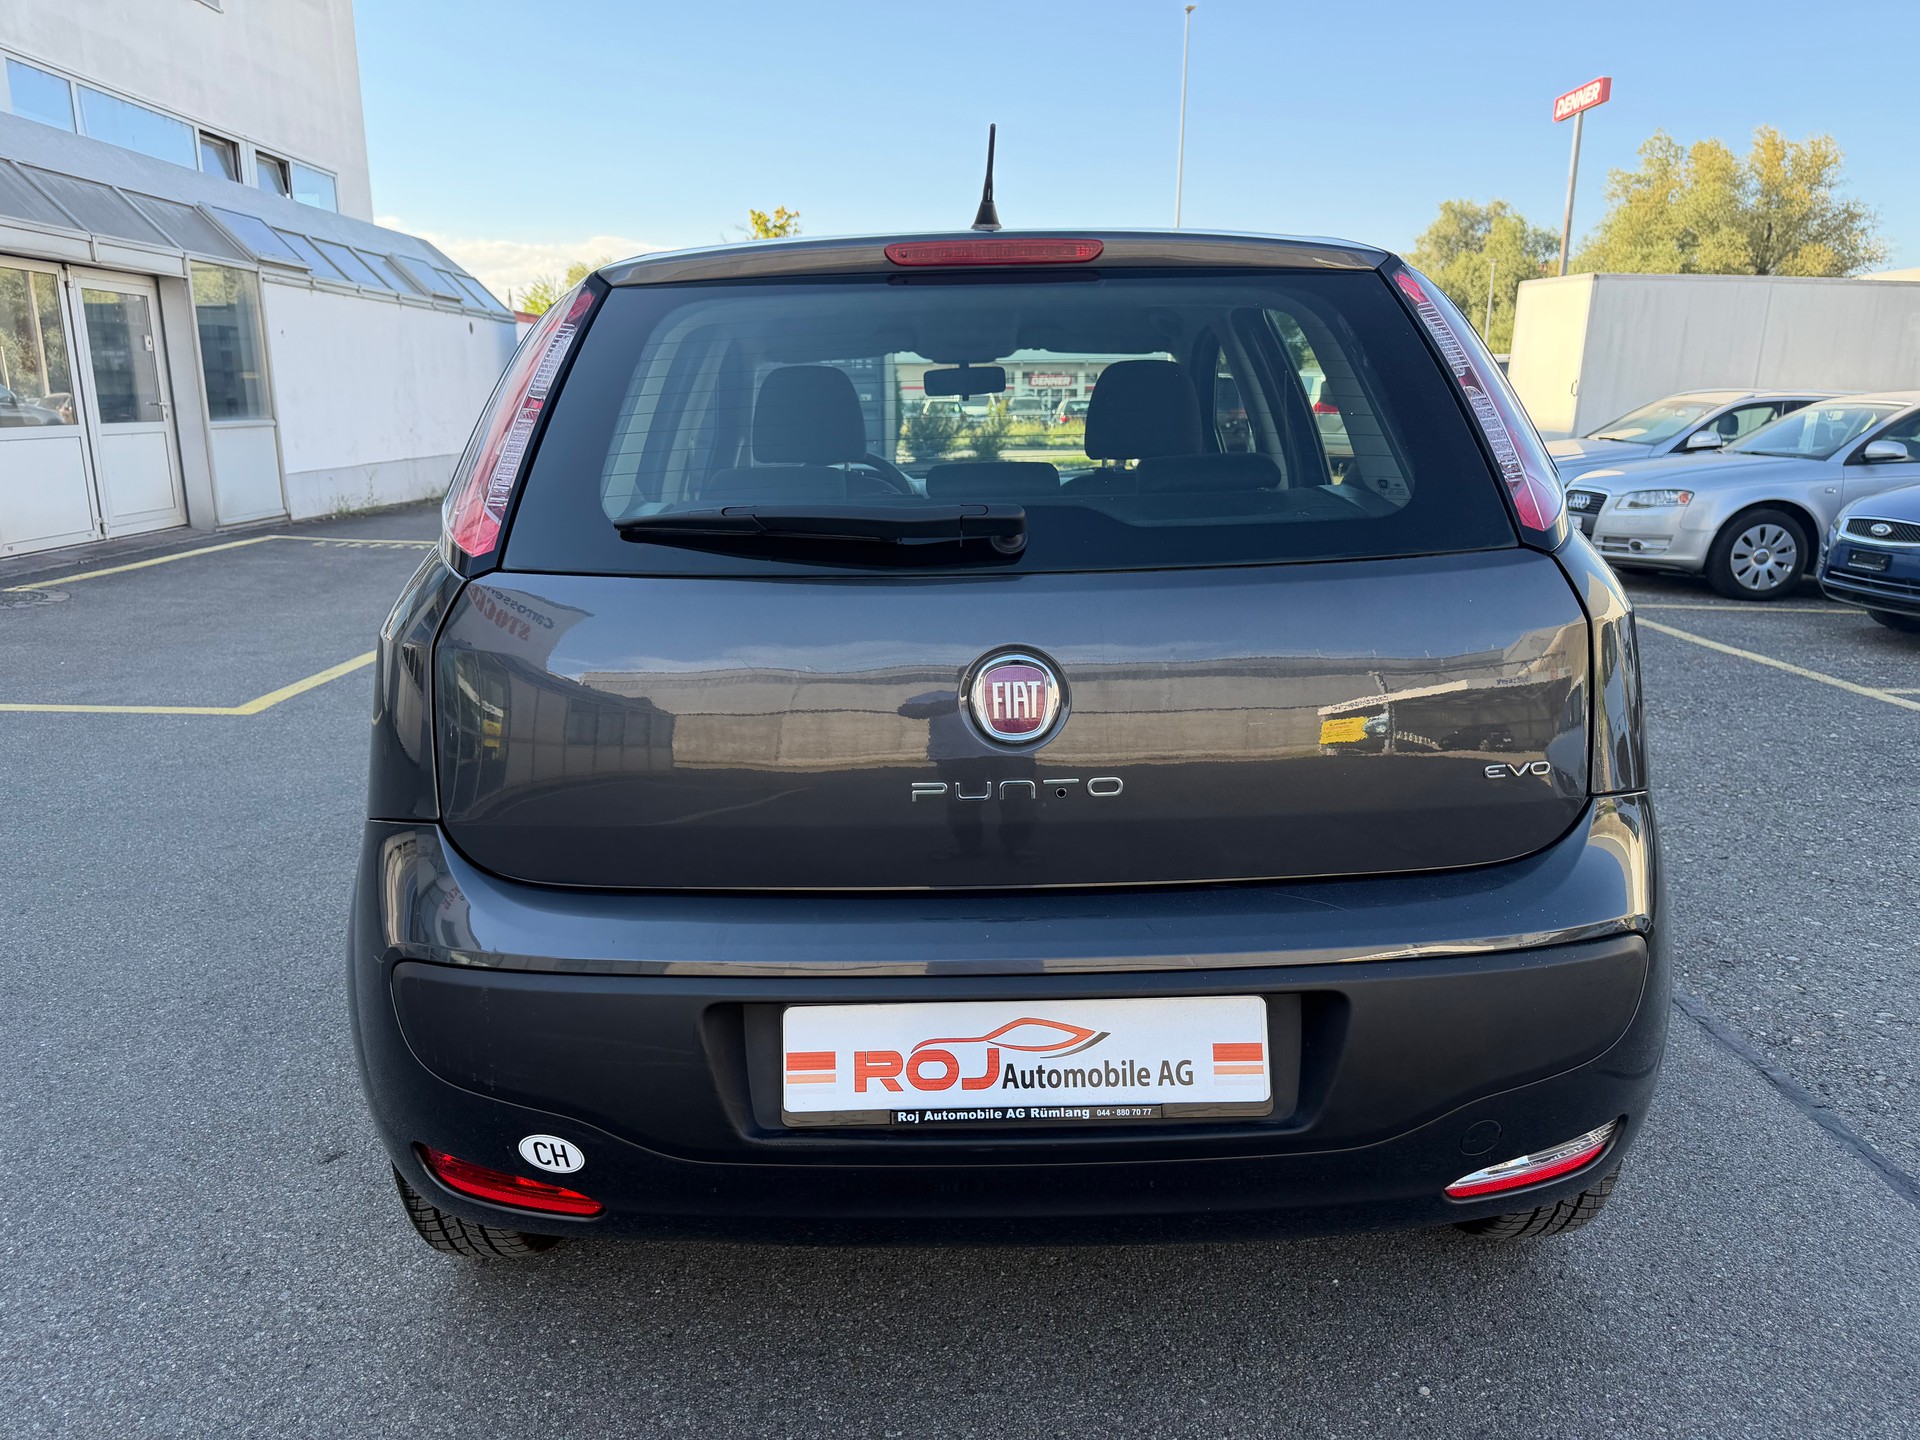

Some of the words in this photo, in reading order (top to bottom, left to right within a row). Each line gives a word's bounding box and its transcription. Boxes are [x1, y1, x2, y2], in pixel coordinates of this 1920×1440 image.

[1555, 81, 1601, 118] DENNER
[1031, 375, 1071, 386] DENNER
[992, 680, 1042, 720] FIAT
[1484, 761, 1551, 780] EVO
[911, 776, 1124, 803] PUNTO
[853, 1047, 1001, 1093] ROJ
[1002, 1060, 1151, 1089] Automobile
[1157, 1060, 1194, 1087] AG
[897, 1111, 919, 1124] Roj
[924, 1109, 1003, 1121] Automobile
[1006, 1108, 1026, 1119] AG
[1030, 1107, 1090, 1119] Rümlang
[1096, 1109, 1111, 1117] 044
[1132, 1108, 1141, 1116] 70
[533, 1141, 571, 1168] CH
